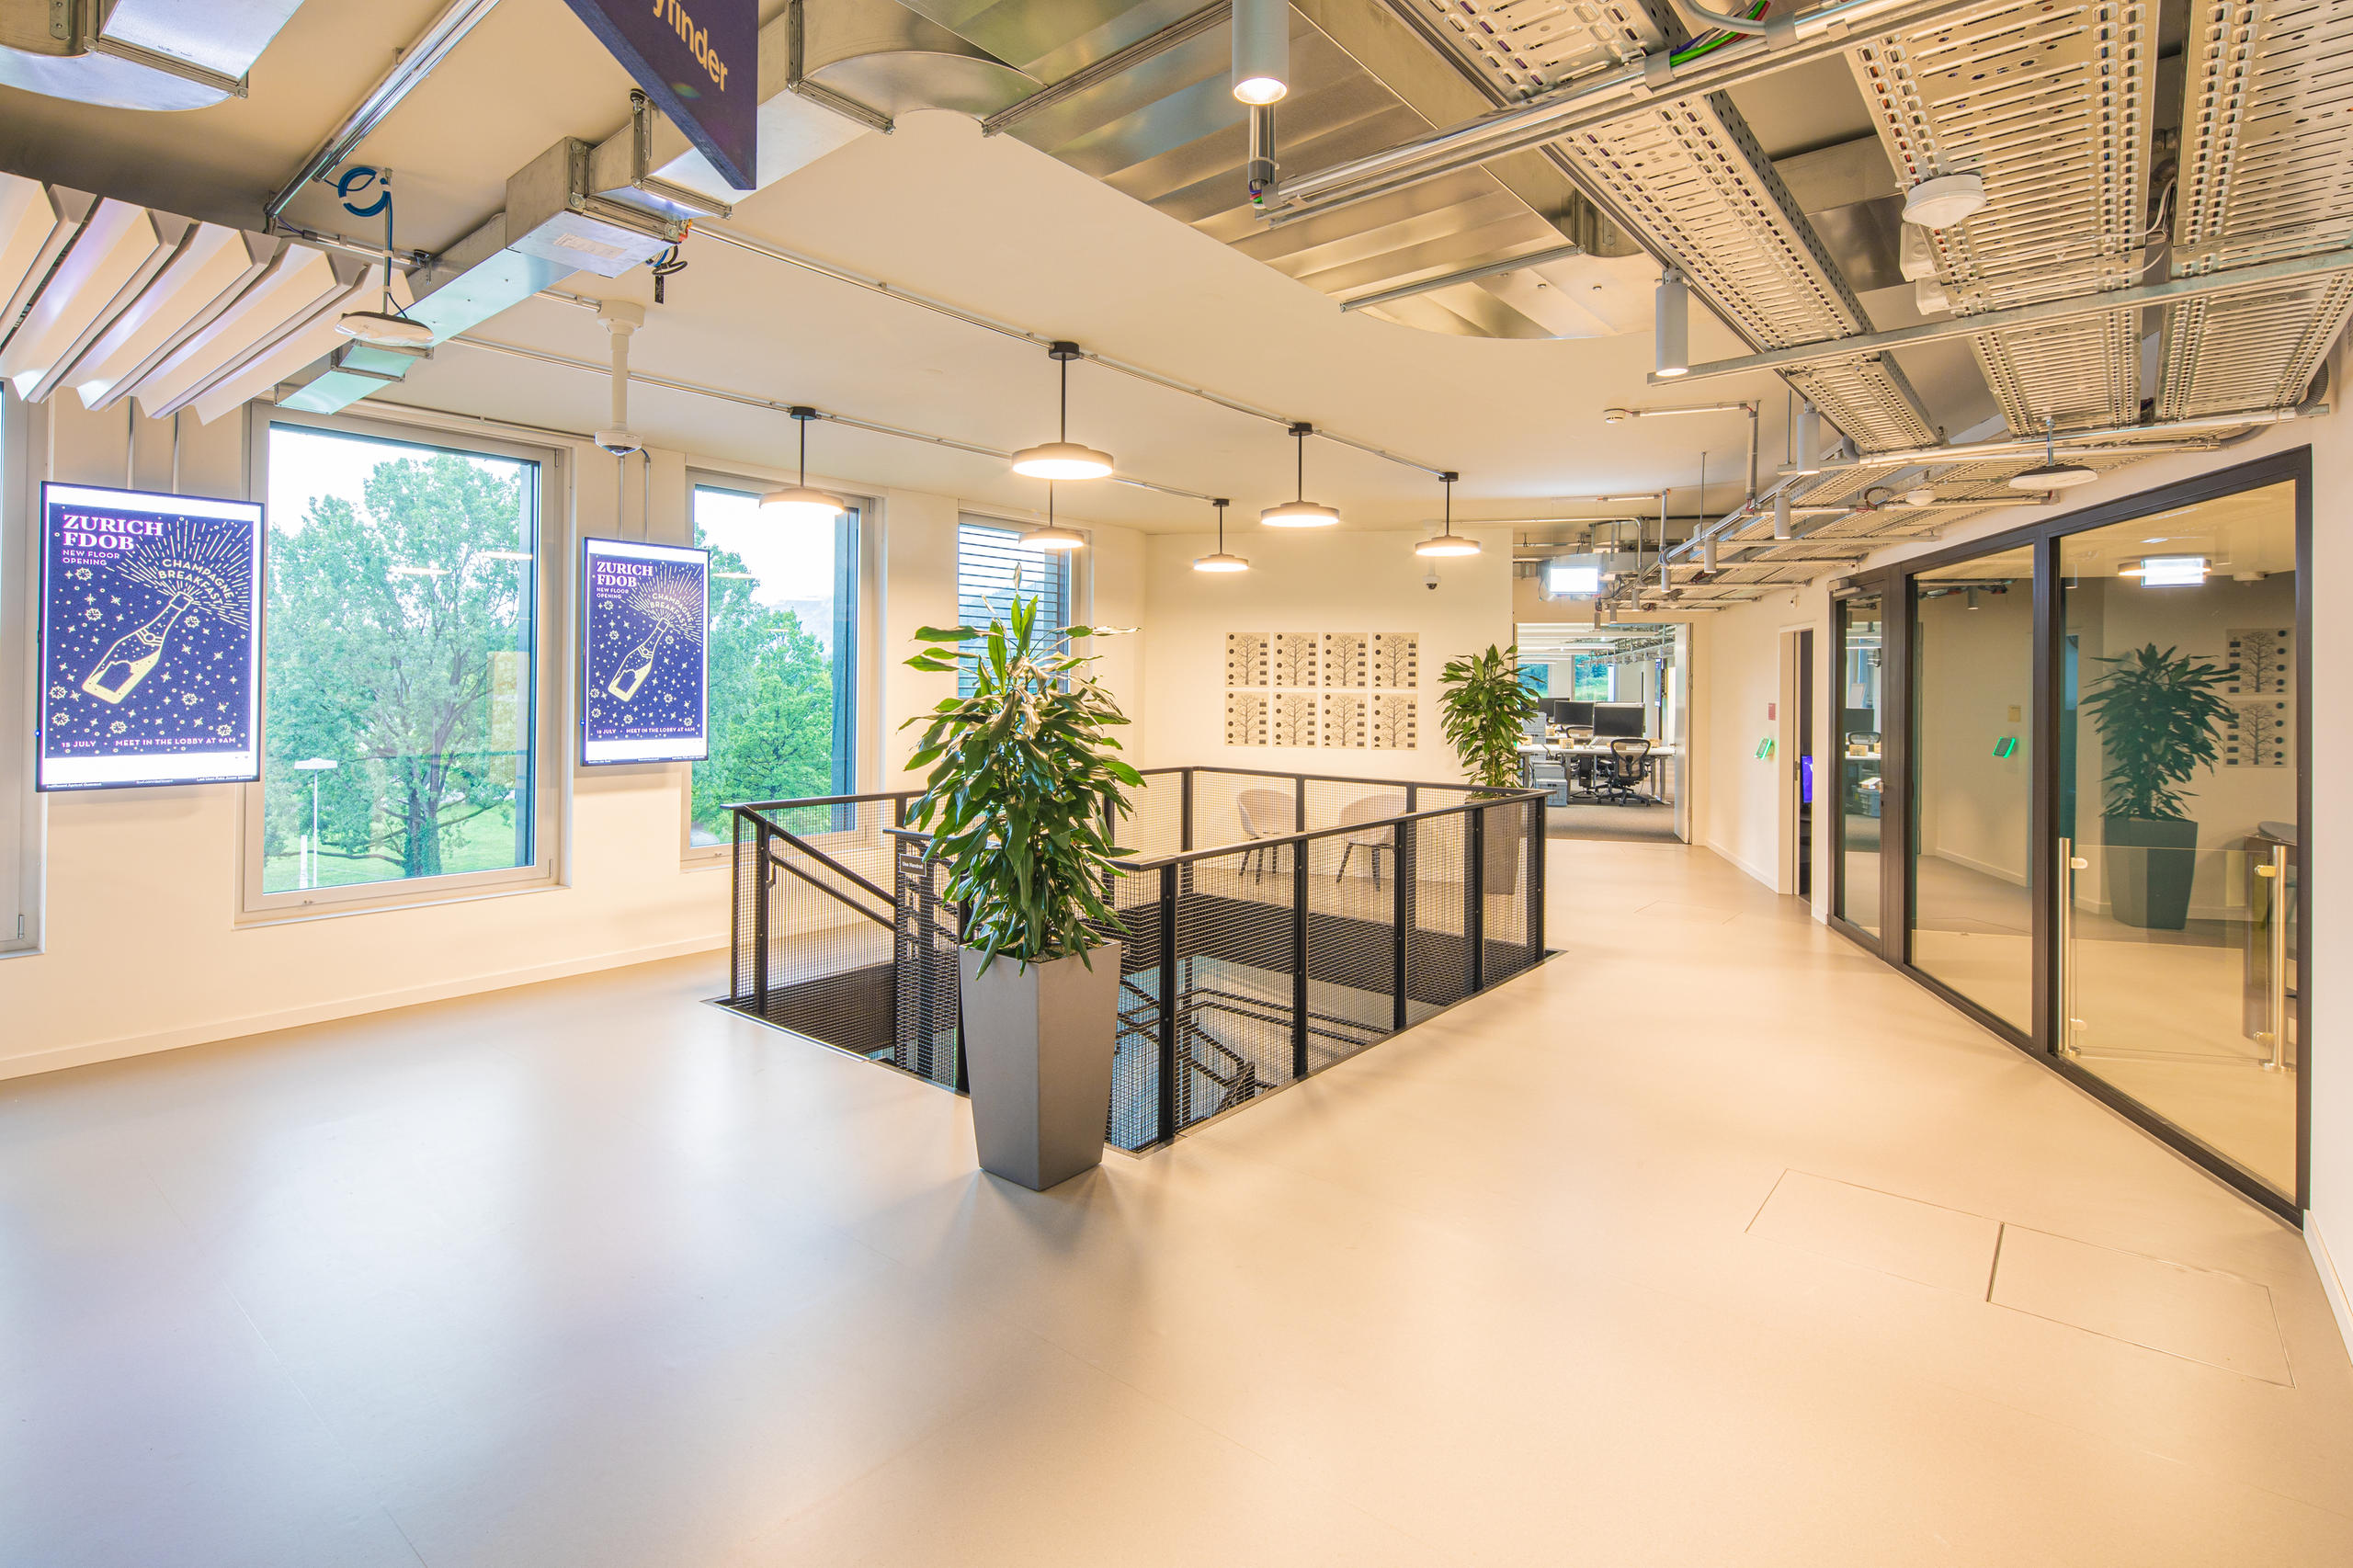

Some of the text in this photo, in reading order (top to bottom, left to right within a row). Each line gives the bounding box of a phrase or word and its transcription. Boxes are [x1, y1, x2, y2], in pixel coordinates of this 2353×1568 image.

[63, 514, 164, 536] ZURICH
[63, 531, 134, 550] FDOB
[63, 557, 108, 565] OPENING
[87, 551, 119, 559] FLOOR
[162, 558, 234, 599] CHAMPAGNE
[597, 561, 654, 576] ZURICH
[157, 570, 223, 604] BREAKFAST
[597, 574, 637, 587] FDOB
[650, 601, 688, 627] BREAKFAST
[652, 593, 694, 623] CHAMPAGNE
